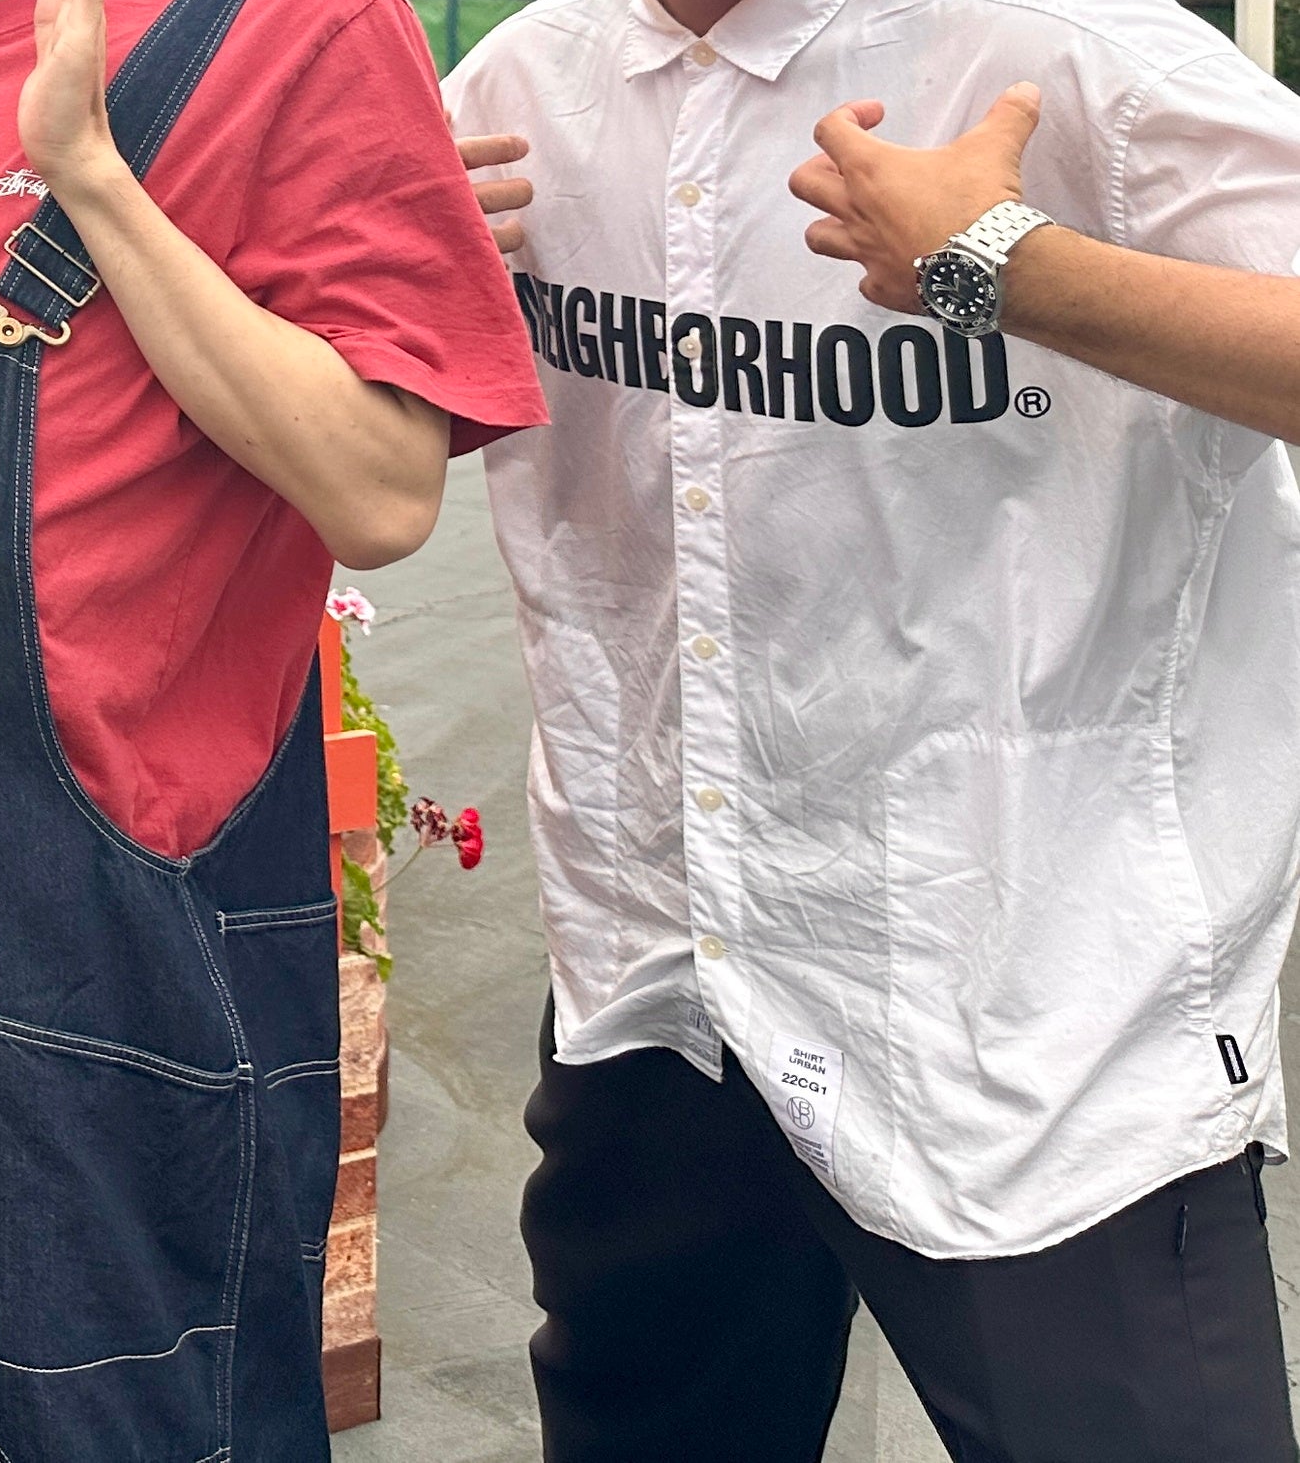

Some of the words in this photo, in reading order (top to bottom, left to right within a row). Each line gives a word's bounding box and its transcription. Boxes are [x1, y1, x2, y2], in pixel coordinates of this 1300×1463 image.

[789, 1055, 826, 1075] URBAN
[793, 1047, 825, 1064] SHIRT
[781, 1072, 828, 1095] 22CG1
